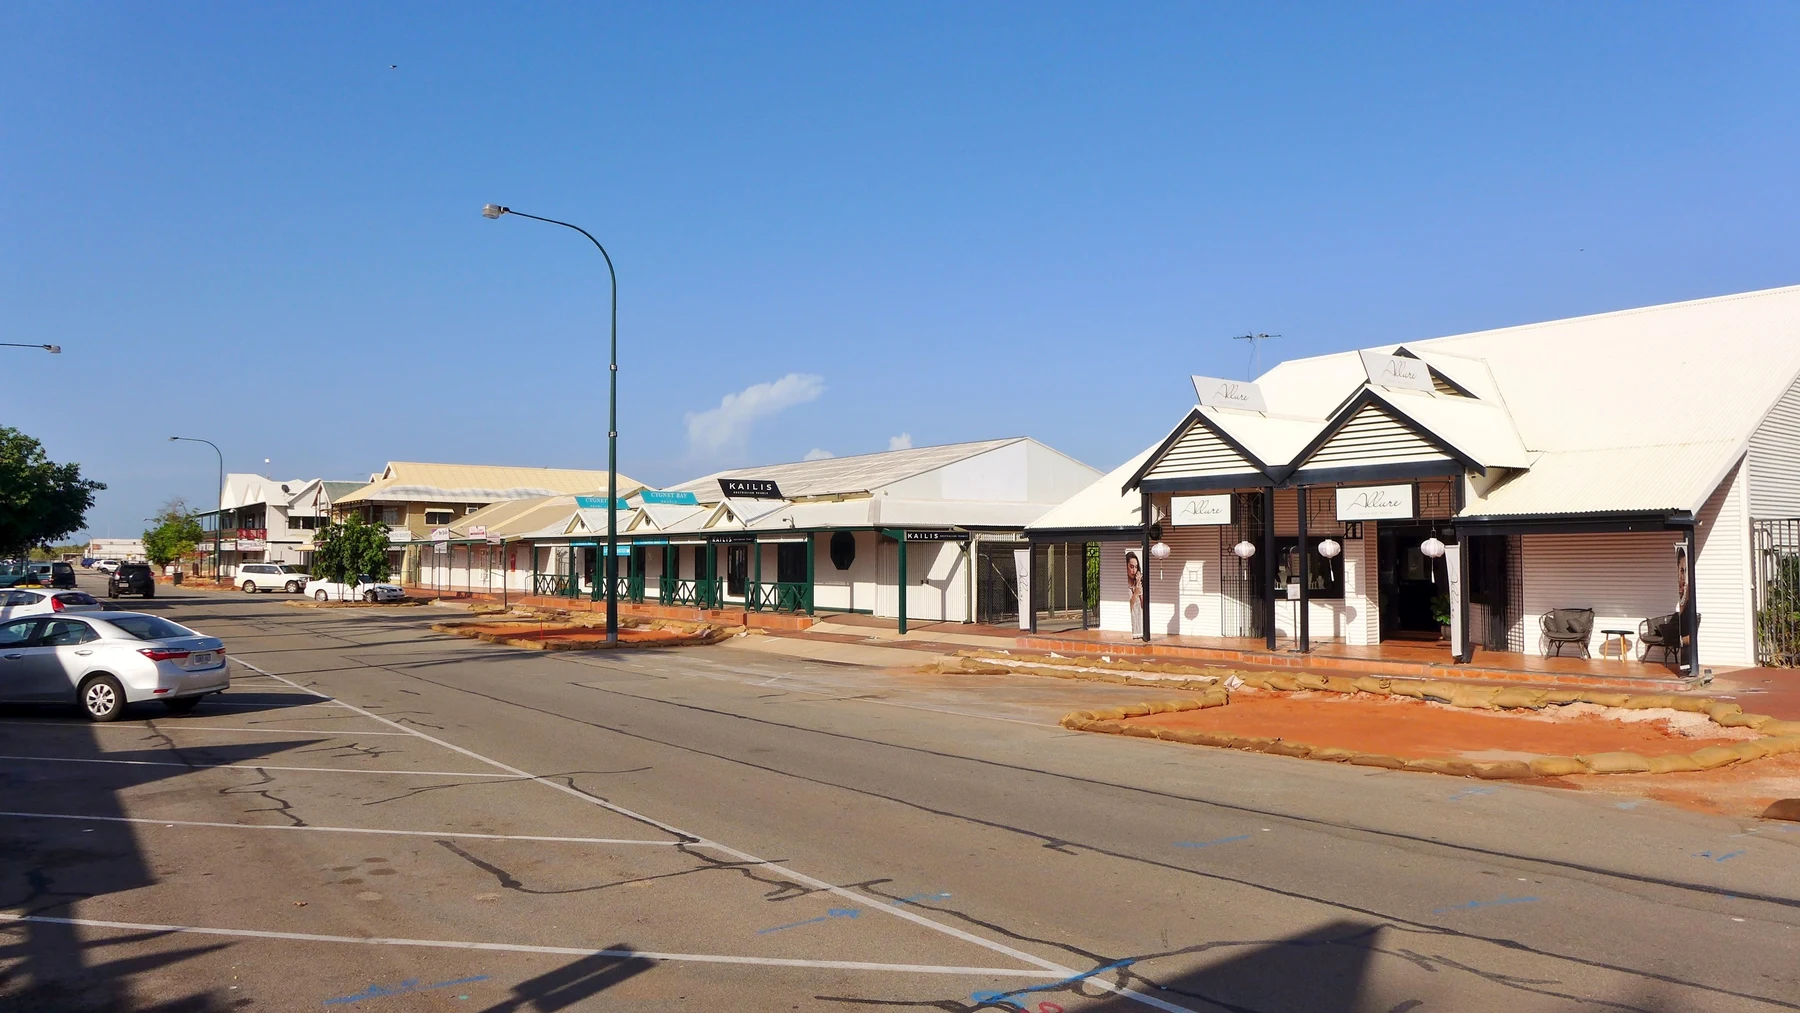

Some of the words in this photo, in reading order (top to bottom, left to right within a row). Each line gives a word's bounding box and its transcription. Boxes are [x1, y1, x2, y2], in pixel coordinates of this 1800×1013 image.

[1381, 359, 1416, 379] Allure
[1213, 383, 1249, 401] Allure
[729, 482, 772, 491] KAILIS
[1179, 499, 1223, 517] Allure
[1346, 490, 1402, 511] Allure
